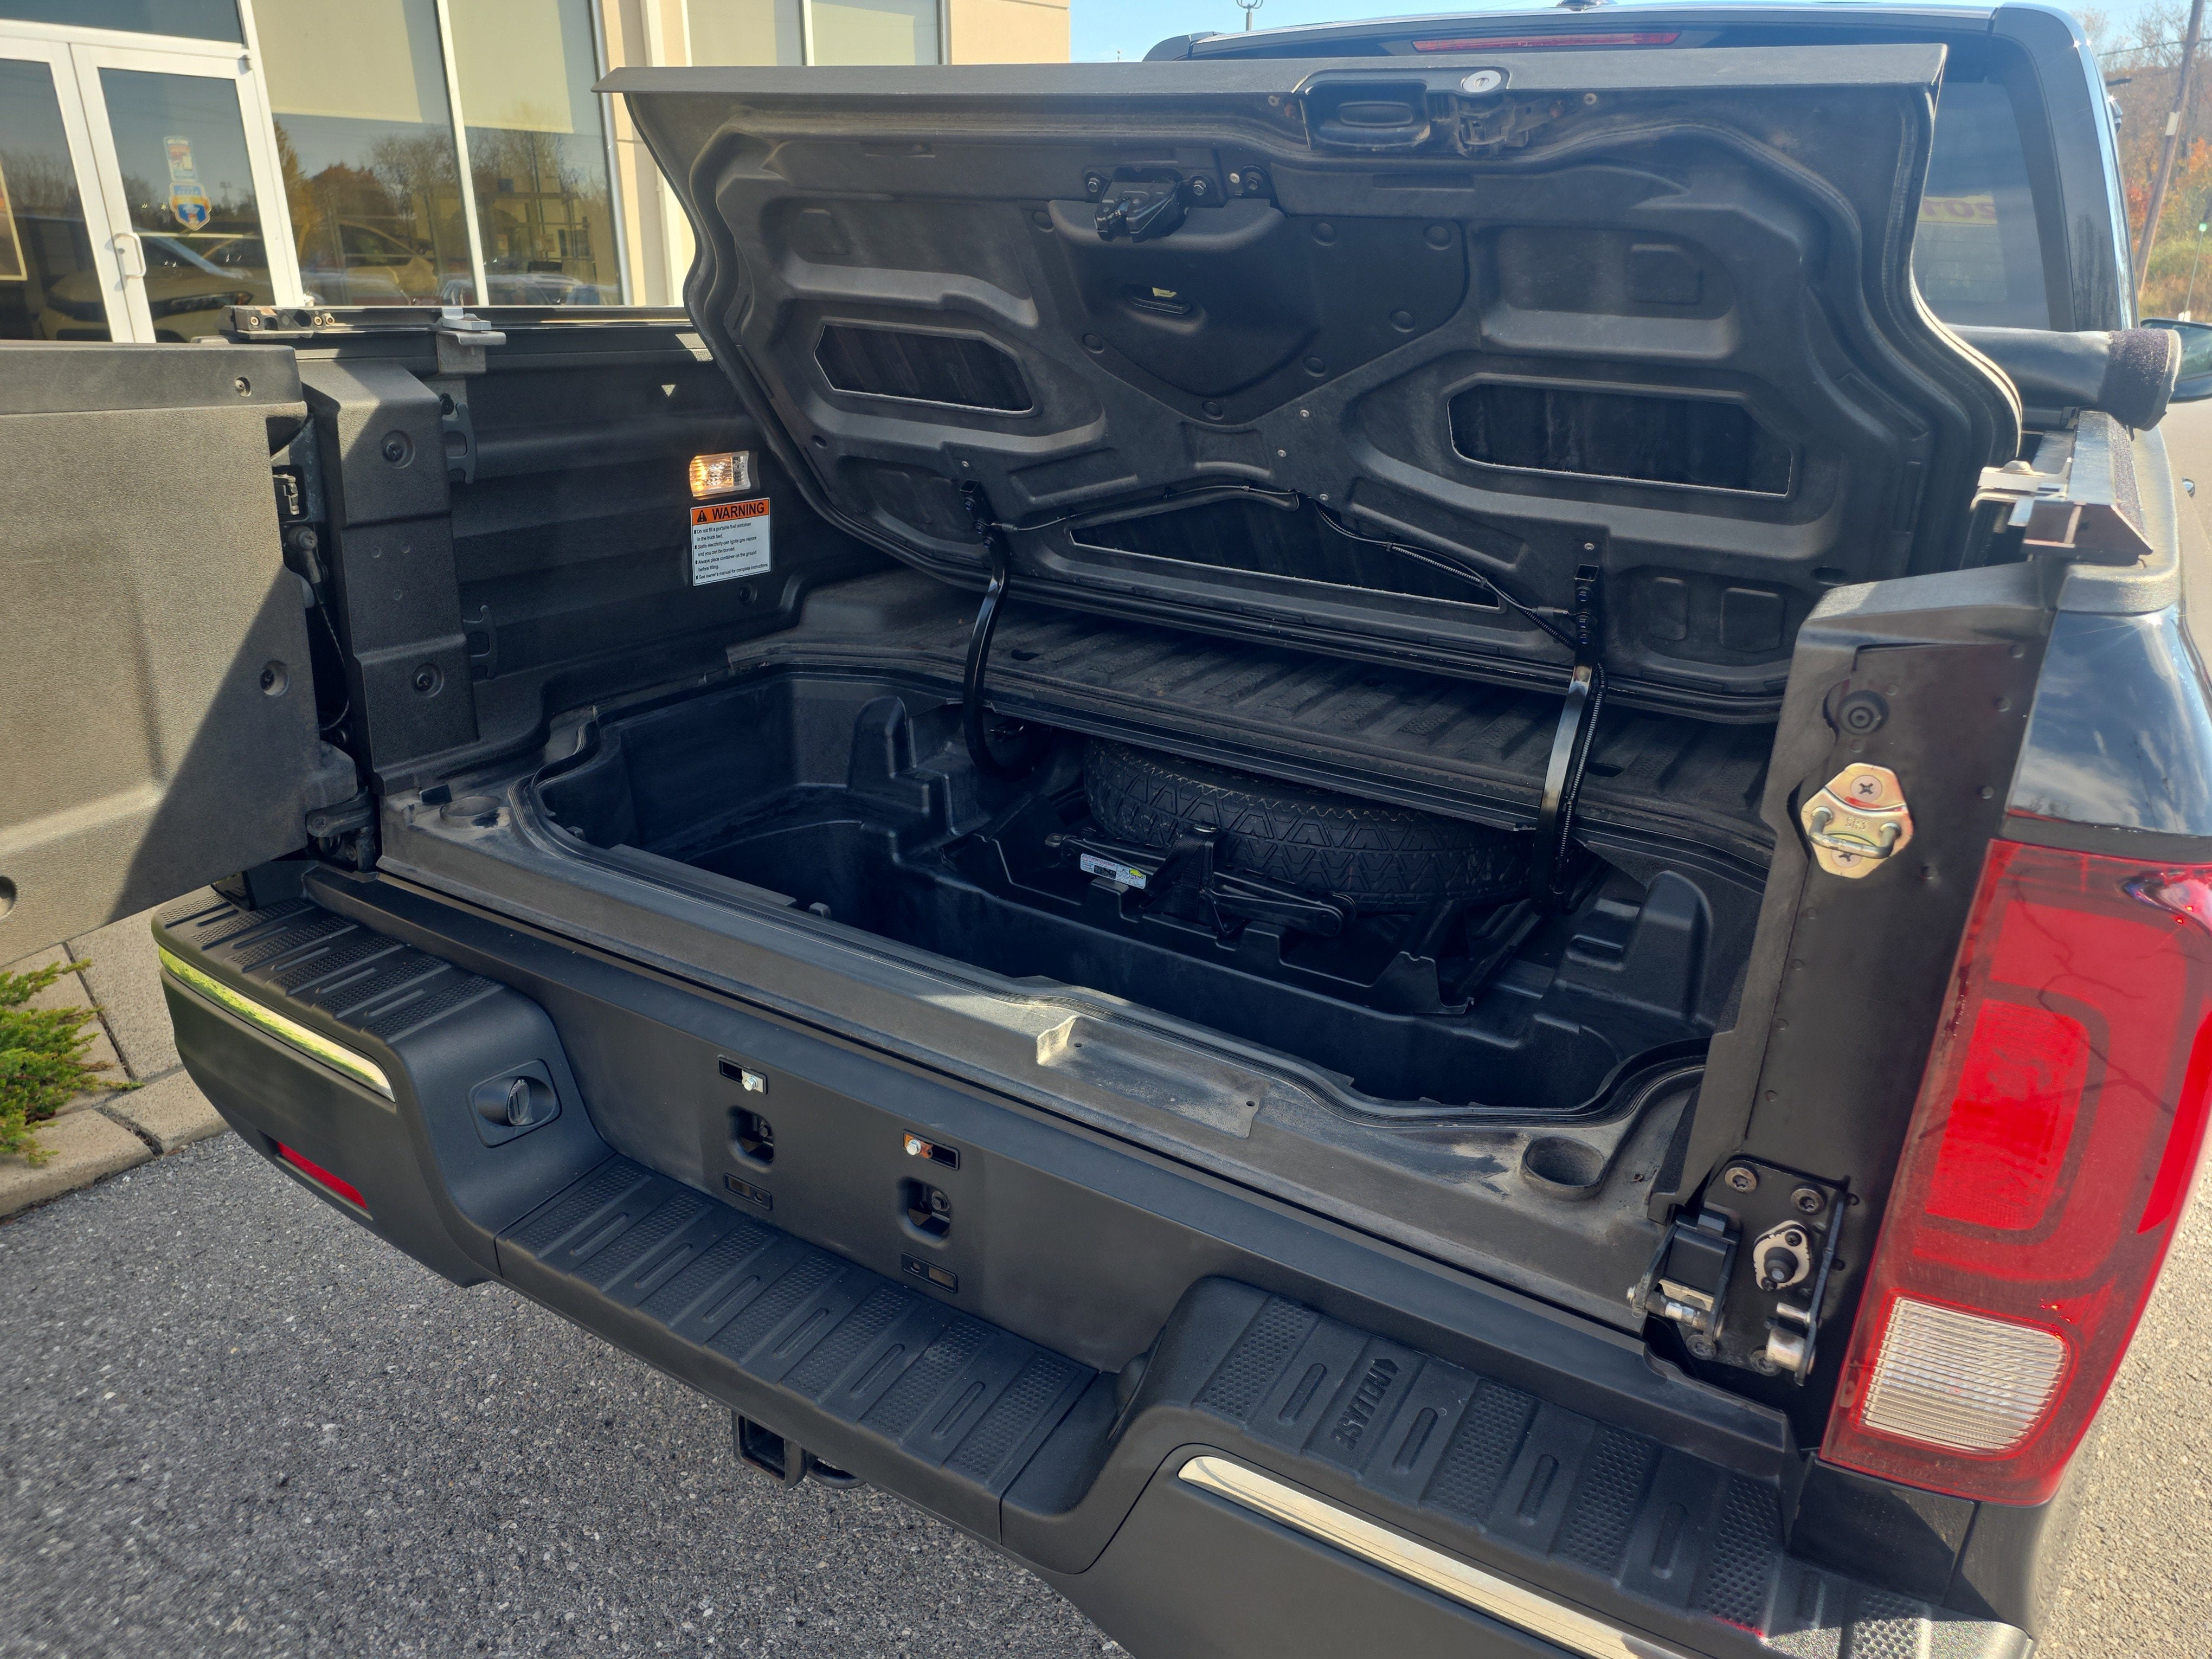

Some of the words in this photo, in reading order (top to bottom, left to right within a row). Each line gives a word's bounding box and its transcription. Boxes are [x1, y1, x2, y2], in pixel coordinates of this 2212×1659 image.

[712, 502, 764, 520] WARNING
[1846, 817, 1866, 831] SR3
[1330, 1367, 1392, 1450] RELEASE
